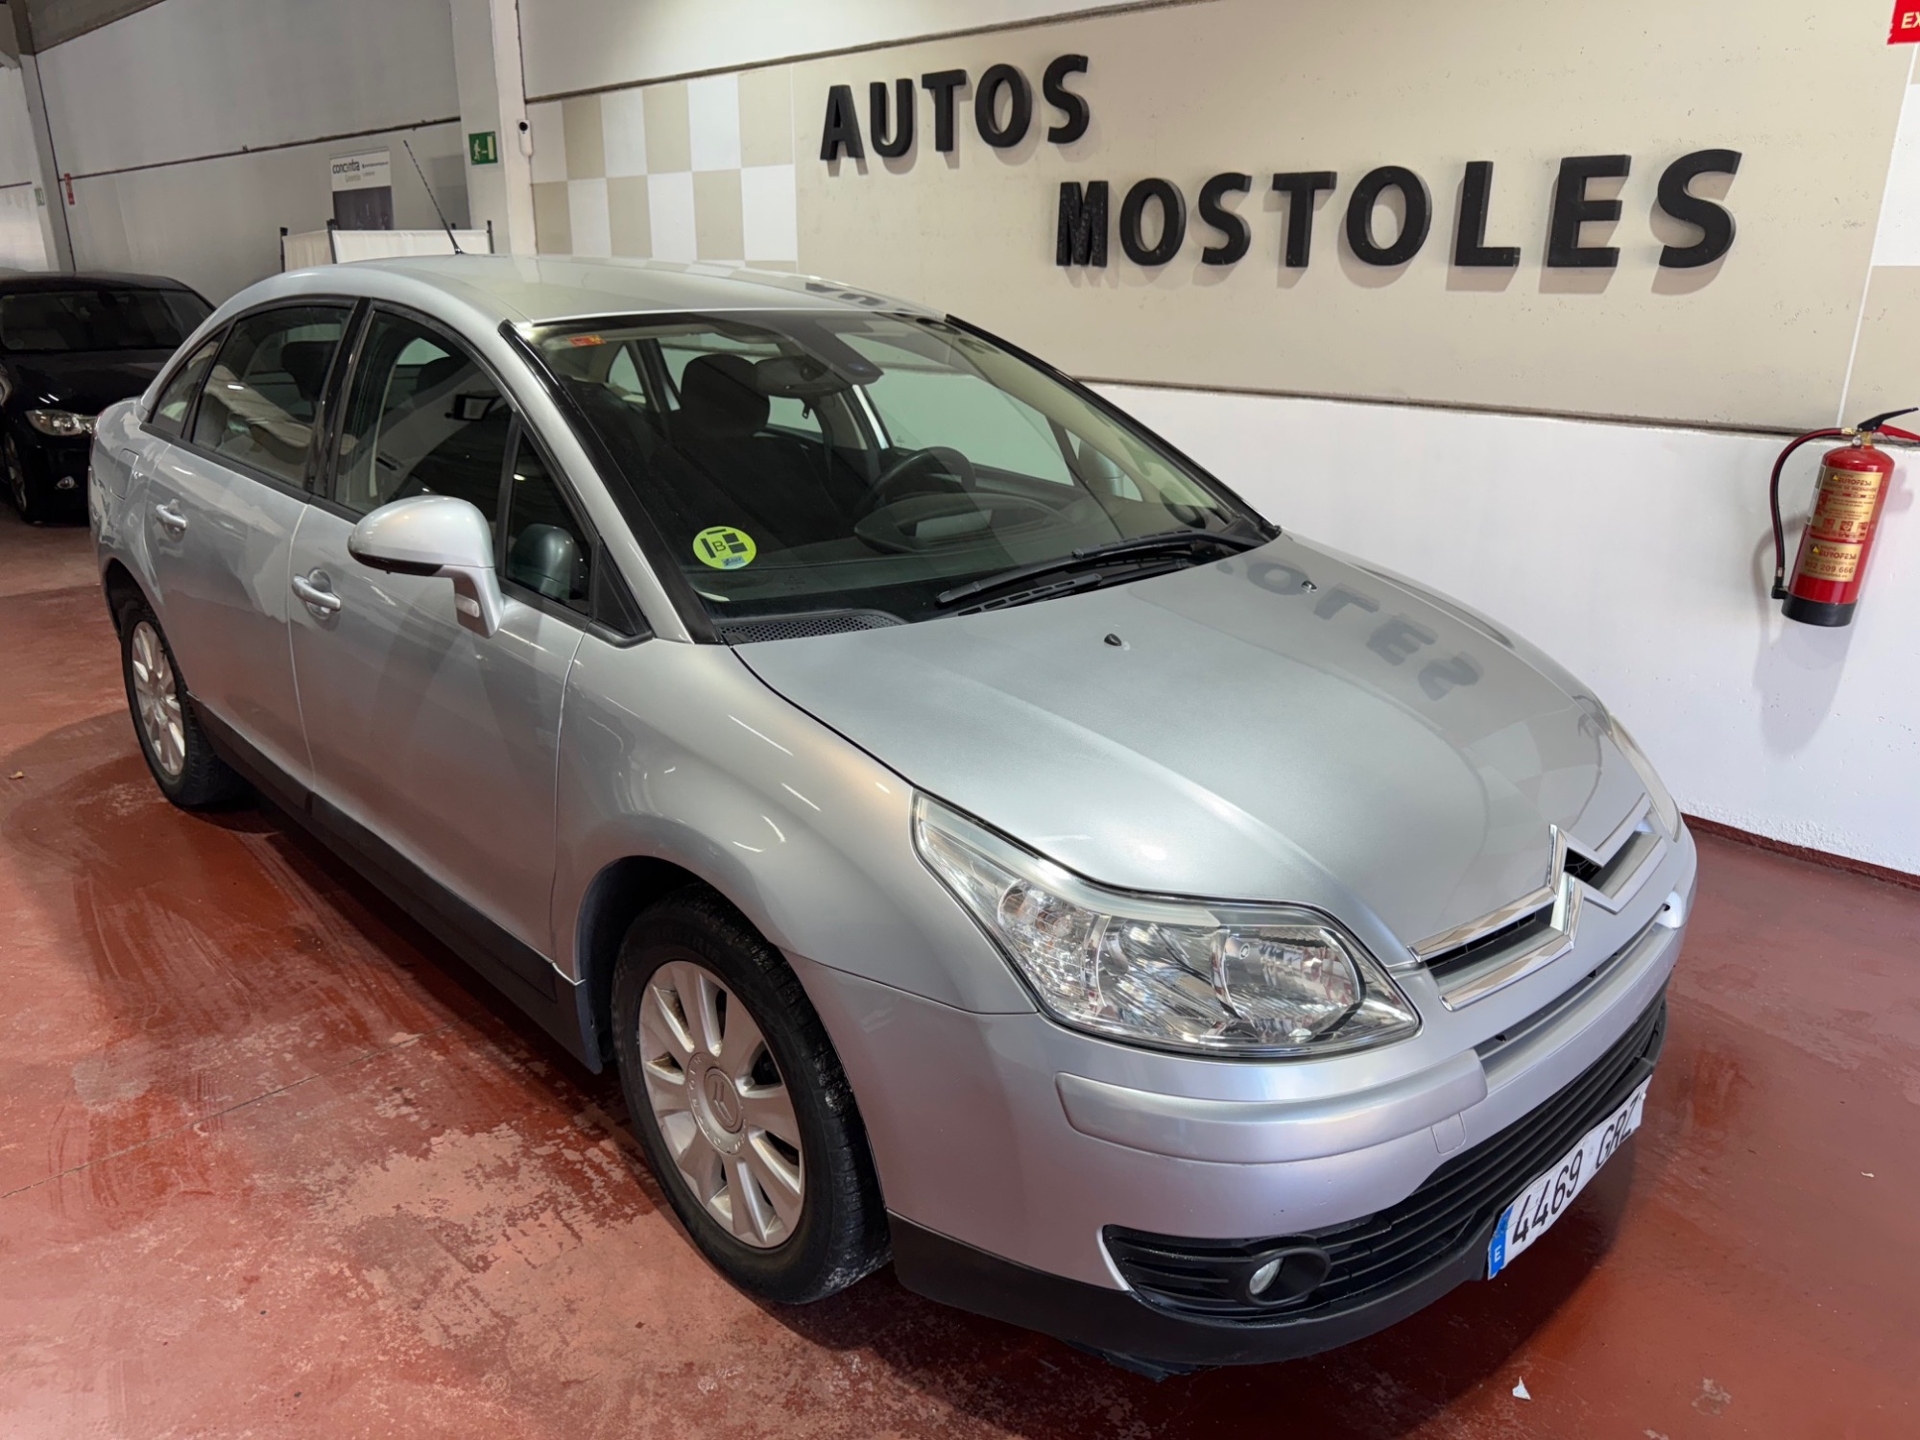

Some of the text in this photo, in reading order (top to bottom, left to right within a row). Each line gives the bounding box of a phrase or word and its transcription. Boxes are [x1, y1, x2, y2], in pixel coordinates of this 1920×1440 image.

[820, 53, 1090, 161] AUTOS
[1056, 148, 1742, 269] MOSTOLES
[712, 541, 726, 552] B
[1511, 1091, 1641, 1246] 4469 GRZ
[1493, 1244, 1502, 1264] E
